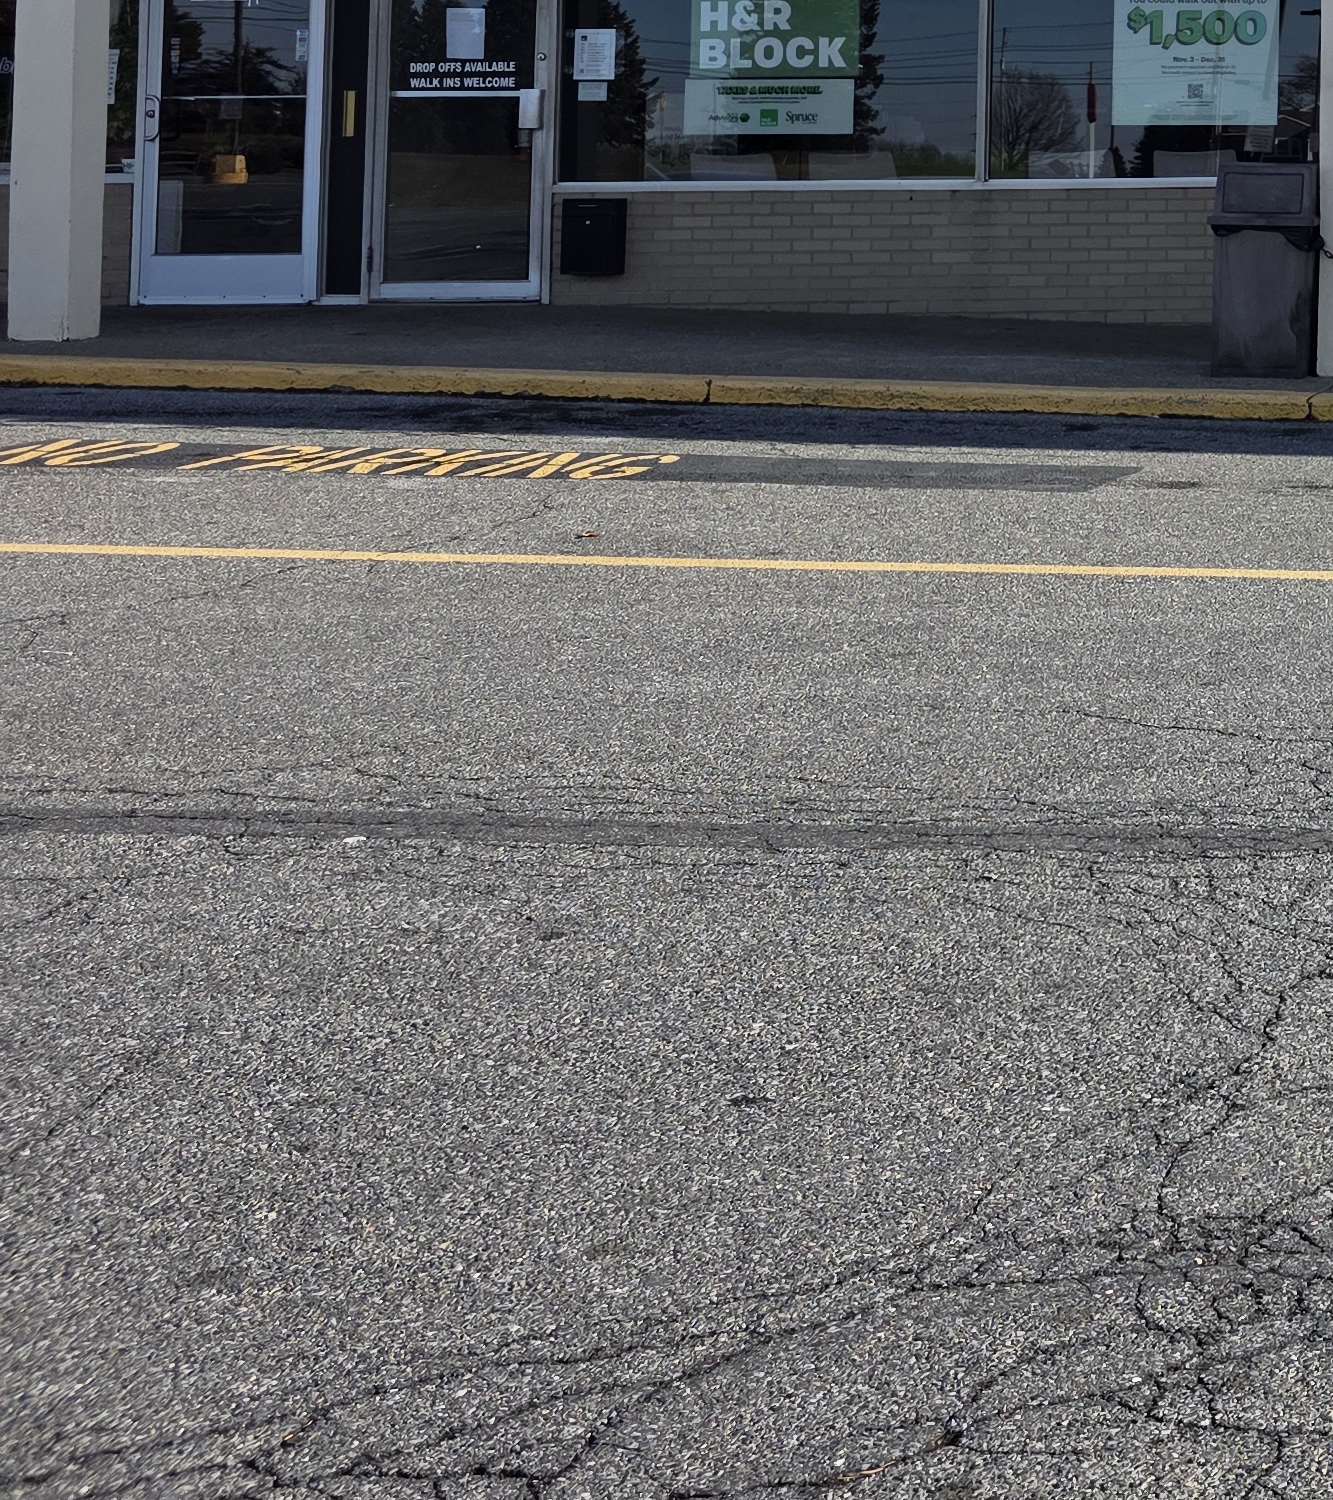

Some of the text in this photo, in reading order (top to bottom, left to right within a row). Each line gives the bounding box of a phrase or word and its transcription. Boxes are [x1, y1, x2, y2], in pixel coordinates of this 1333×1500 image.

[700, 0, 792, 32] H&R
[1127, 6, 1267, 50] $1,500
[700, 36, 847, 69] BLOCK
[409, 61, 516, 73] DROP OFFS AVAILABLE
[410, 77, 516, 88] WALK INS WELCOME
[785, 111, 818, 125] Spruce
